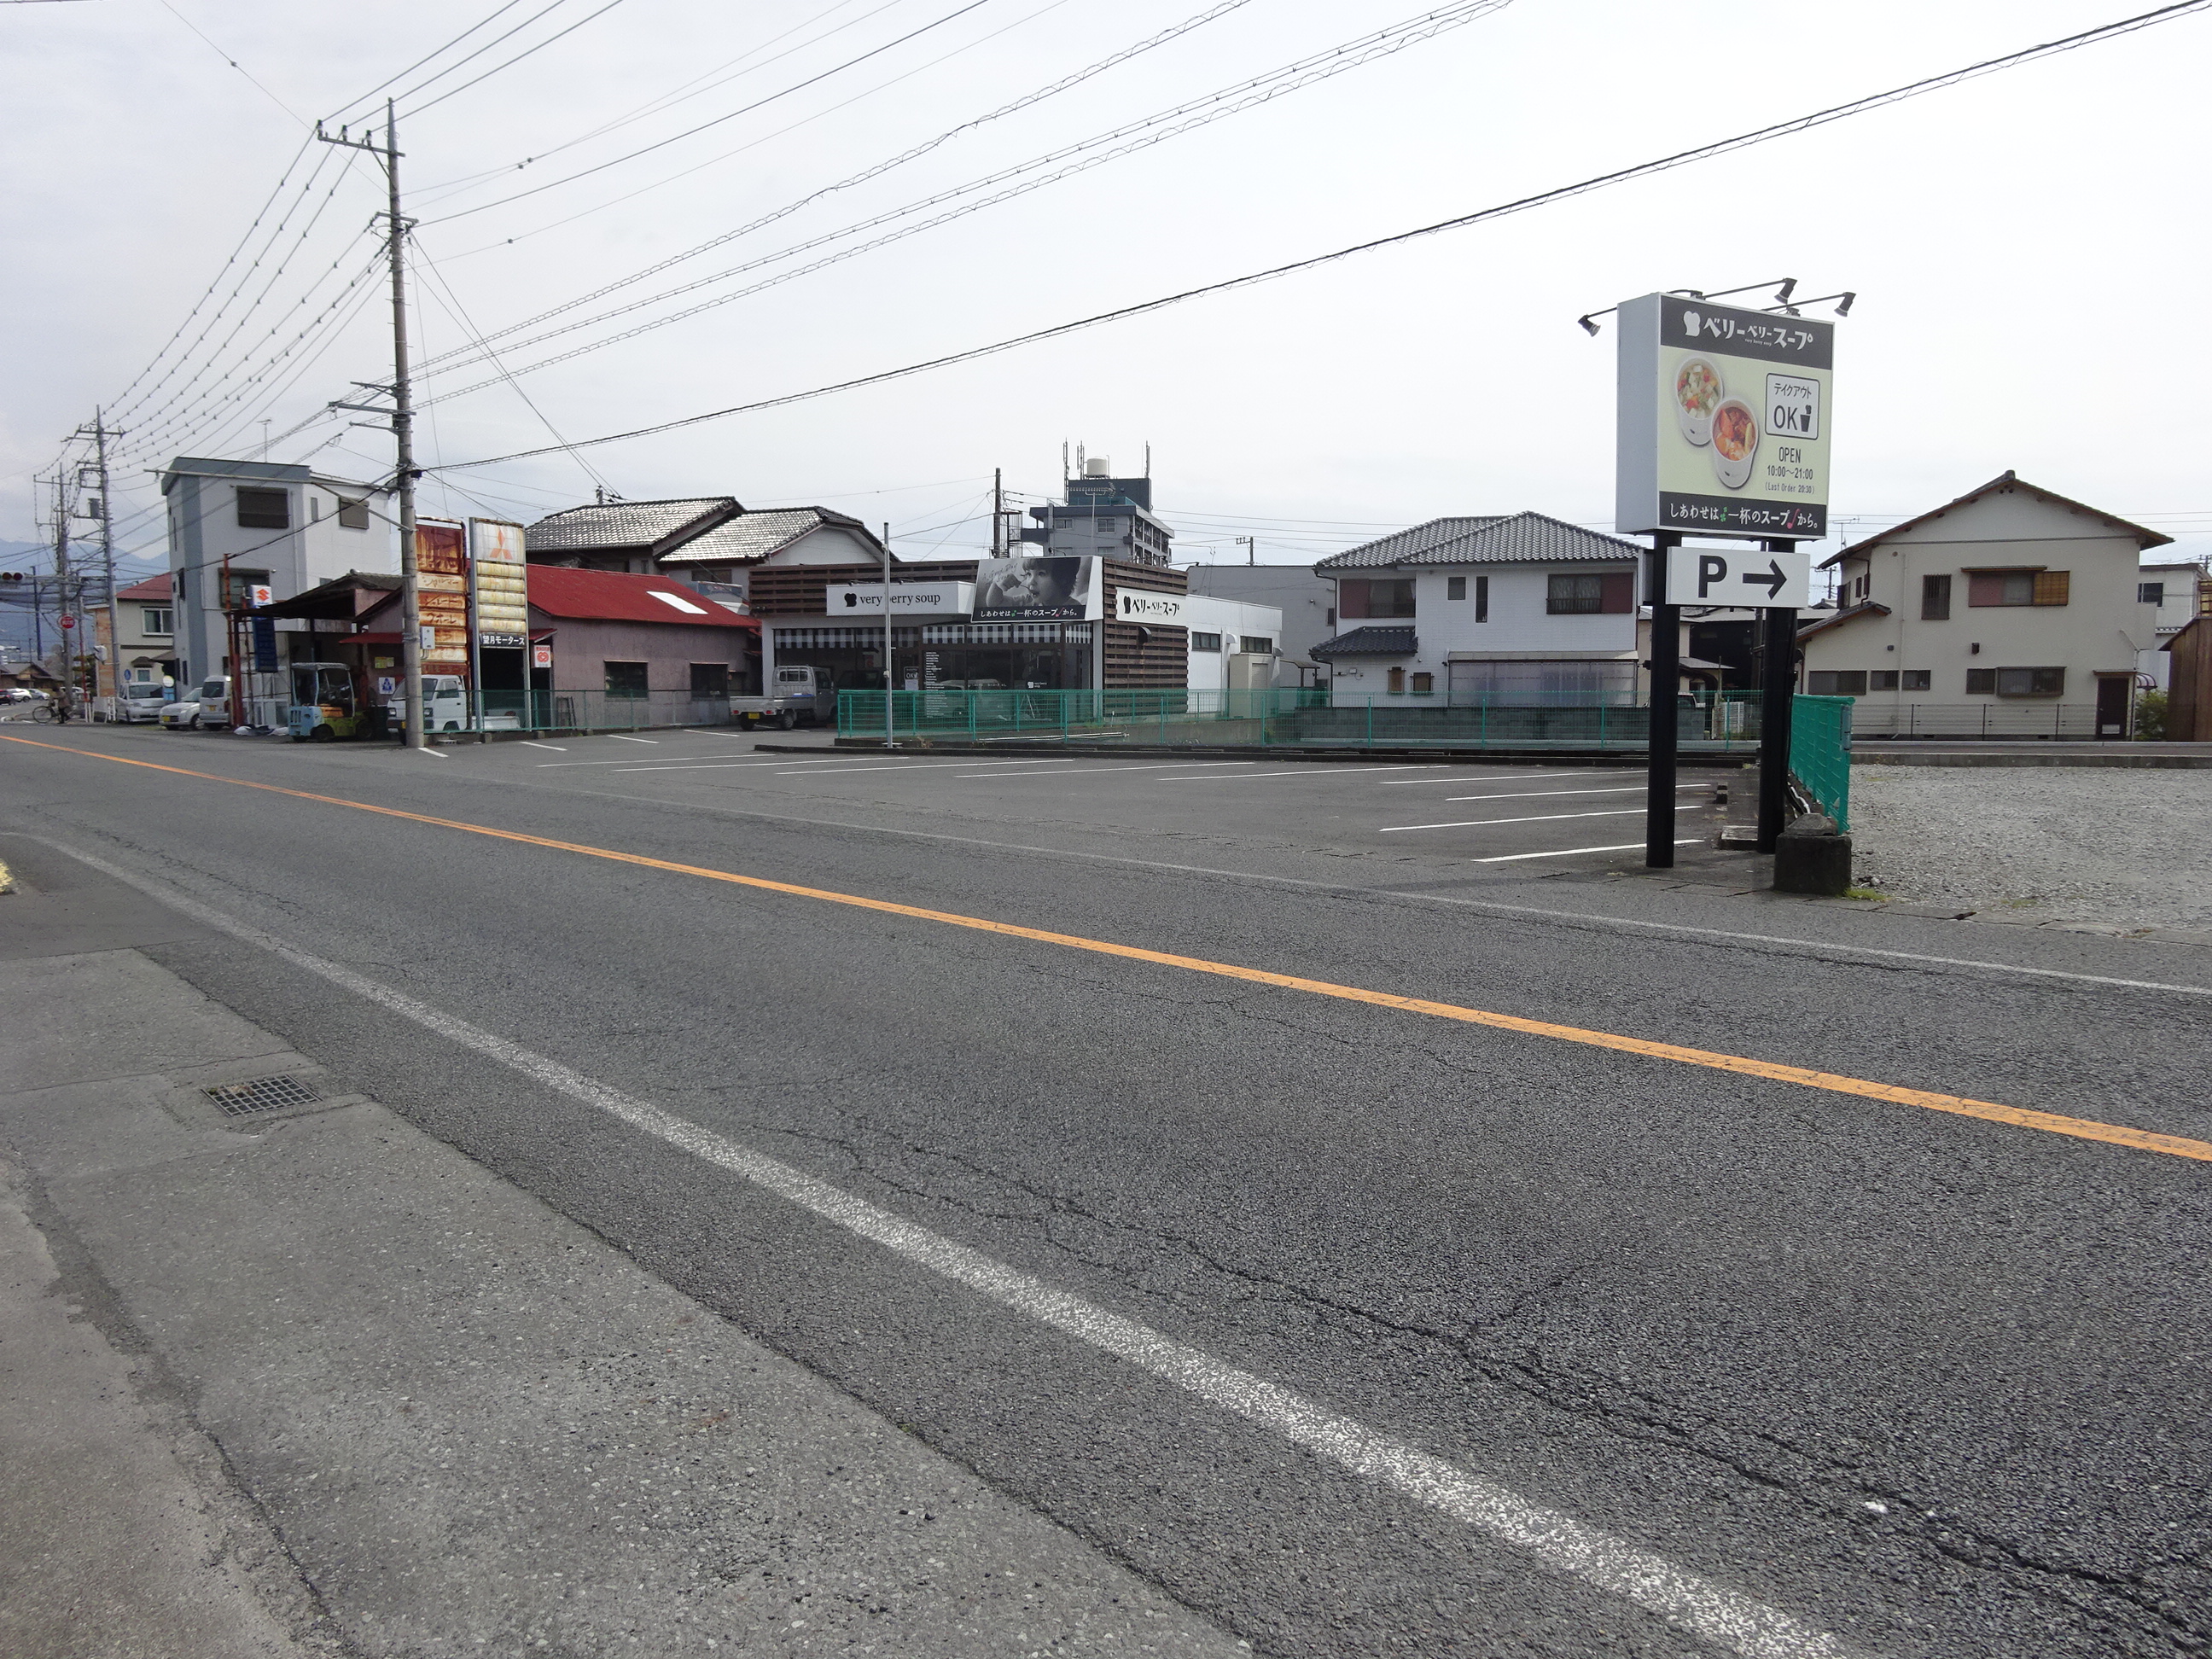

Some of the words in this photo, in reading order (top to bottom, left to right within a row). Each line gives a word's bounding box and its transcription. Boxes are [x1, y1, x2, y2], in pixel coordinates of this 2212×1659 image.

[1773, 382, 1812, 399] テイクアウト
[1773, 405, 1798, 431] OK
[1778, 446, 1802, 463] OPEN
[1765, 481, 1780, 491] (Last
[1781, 483, 1796, 492] Order
[1698, 555, 1727, 599] P
[859, 595, 883, 607] very
[889, 594, 914, 606] erry
[915, 594, 941, 605] soup
